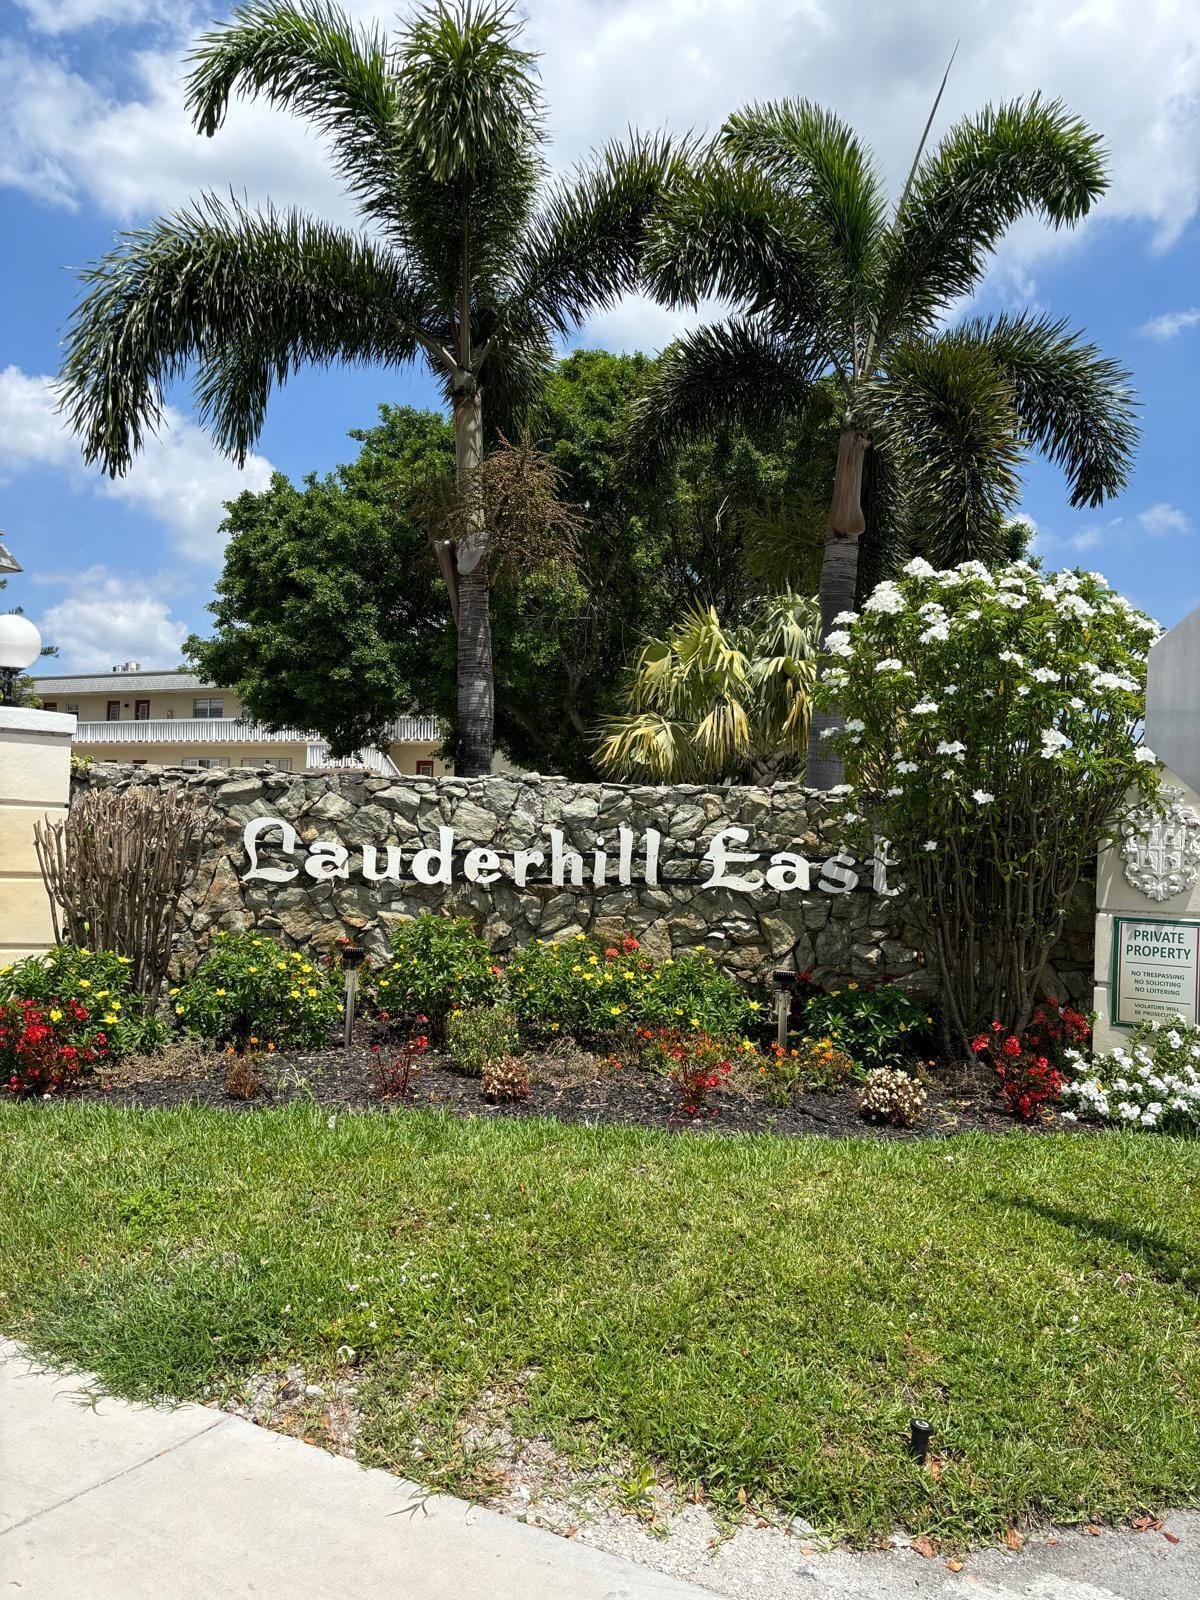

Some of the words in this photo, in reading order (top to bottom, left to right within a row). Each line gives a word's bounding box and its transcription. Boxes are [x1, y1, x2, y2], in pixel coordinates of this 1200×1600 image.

[242, 816, 660, 888] Lauderhill
[702, 827, 906, 896] East
[1134, 929, 1185, 944] PRIVATE
[1126, 944, 1191, 960] PROPERTY
[1143, 971, 1185, 980] TRESPASSING
[1146, 979, 1181, 988] SOLICITING
[1146, 987, 1180, 996] LOITERING
[1134, 1003, 1165, 1011] VIOLATORS
